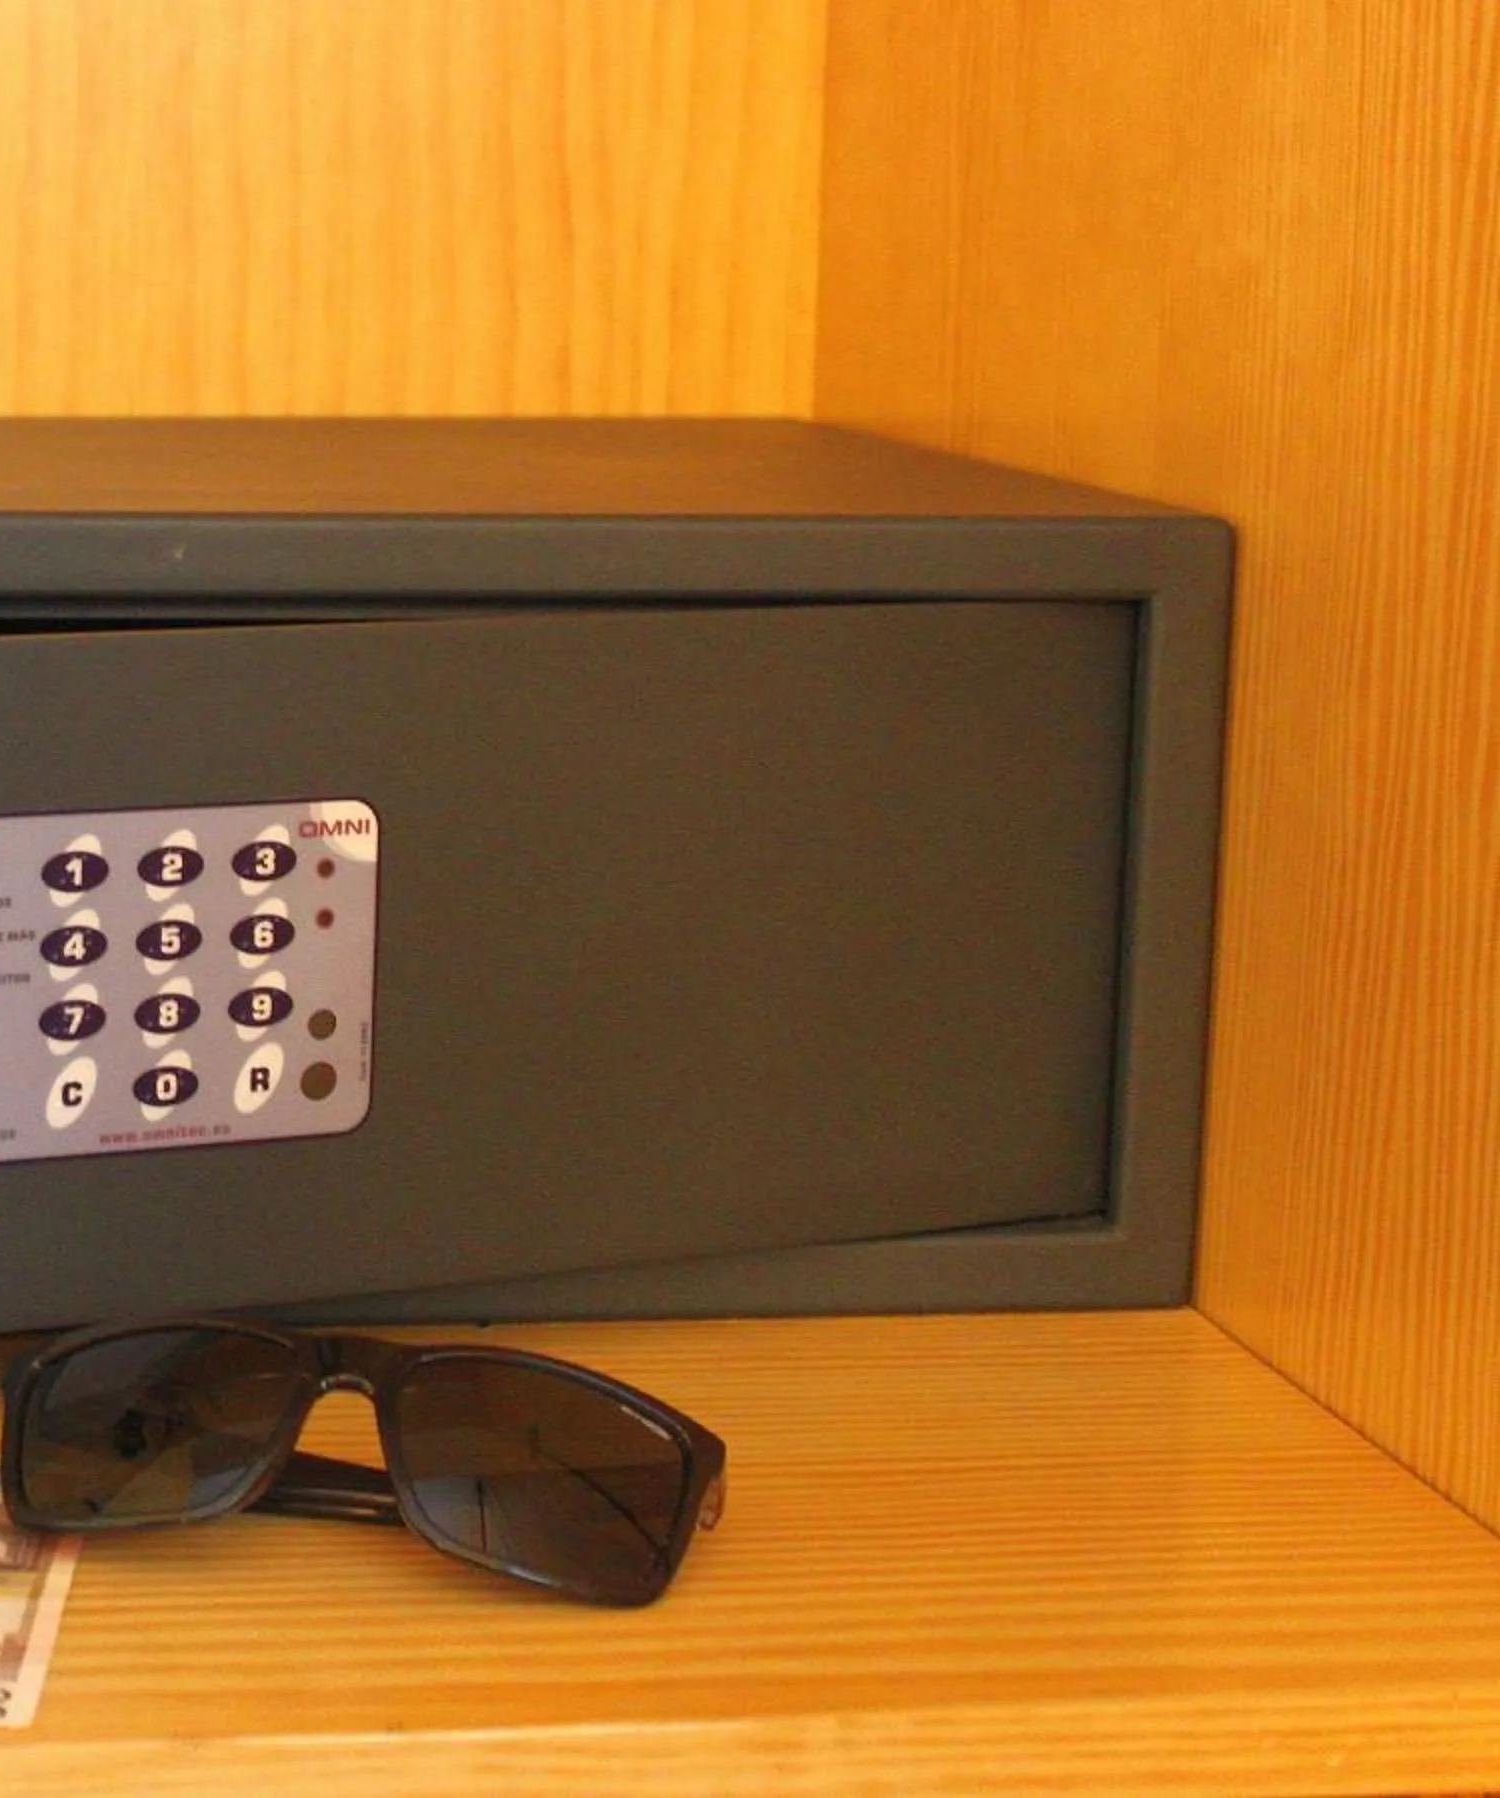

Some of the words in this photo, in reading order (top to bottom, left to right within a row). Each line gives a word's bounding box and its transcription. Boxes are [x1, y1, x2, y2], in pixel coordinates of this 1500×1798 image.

[299, 818, 370, 838] OMNI
[65, 858, 83, 885] 1
[161, 854, 182, 881] 2
[255, 848, 275, 875] 3
[63, 933, 86, 960] 4
[161, 927, 181, 953] 5
[253, 921, 274, 947] 6
[65, 1007, 84, 1034] 7
[159, 1000, 179, 1026] 8
[252, 994, 272, 1020] 9
[61, 1081, 82, 1106] C
[156, 1074, 177, 1100] 0
[250, 1067, 270, 1093] R
